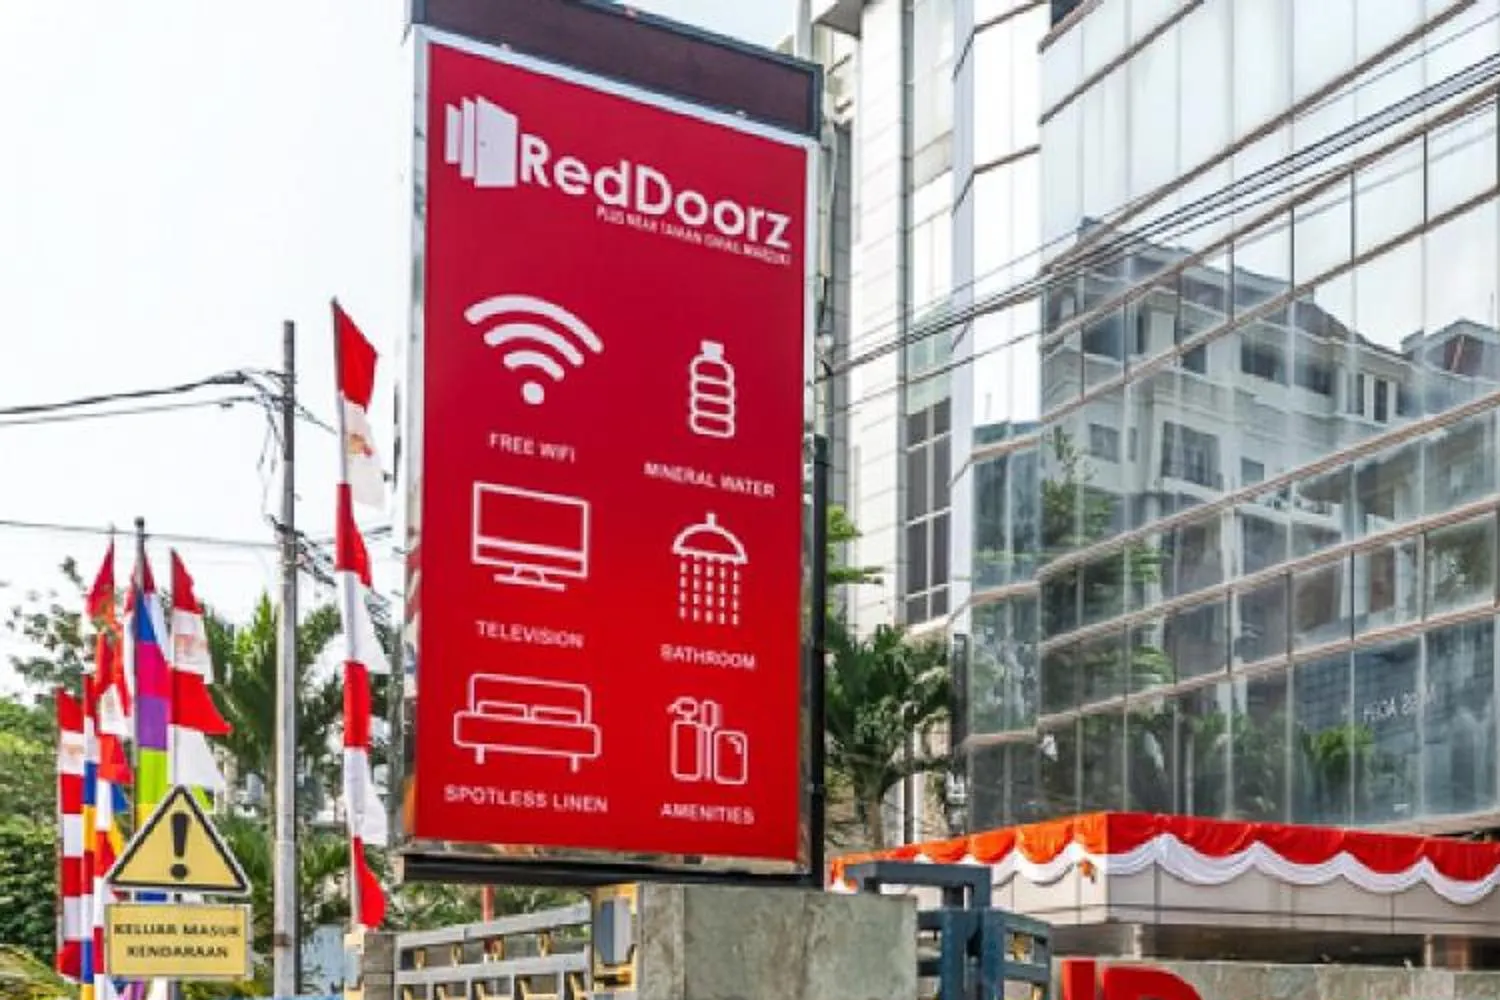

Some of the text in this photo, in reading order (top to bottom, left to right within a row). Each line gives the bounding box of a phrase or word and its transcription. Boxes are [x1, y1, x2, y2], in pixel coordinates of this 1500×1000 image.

[520, 133, 792, 250] RedDoorz
[488, 431, 534, 456] FREE
[643, 461, 776, 498] MINERAL WATER
[475, 620, 584, 650] TELEVISION
[659, 643, 757, 671] BATHROOM
[444, 783, 608, 813] SPOTLESS LINEN
[659, 802, 755, 825] AMENITIES
[126, 945, 229, 959] KENDARAAN
